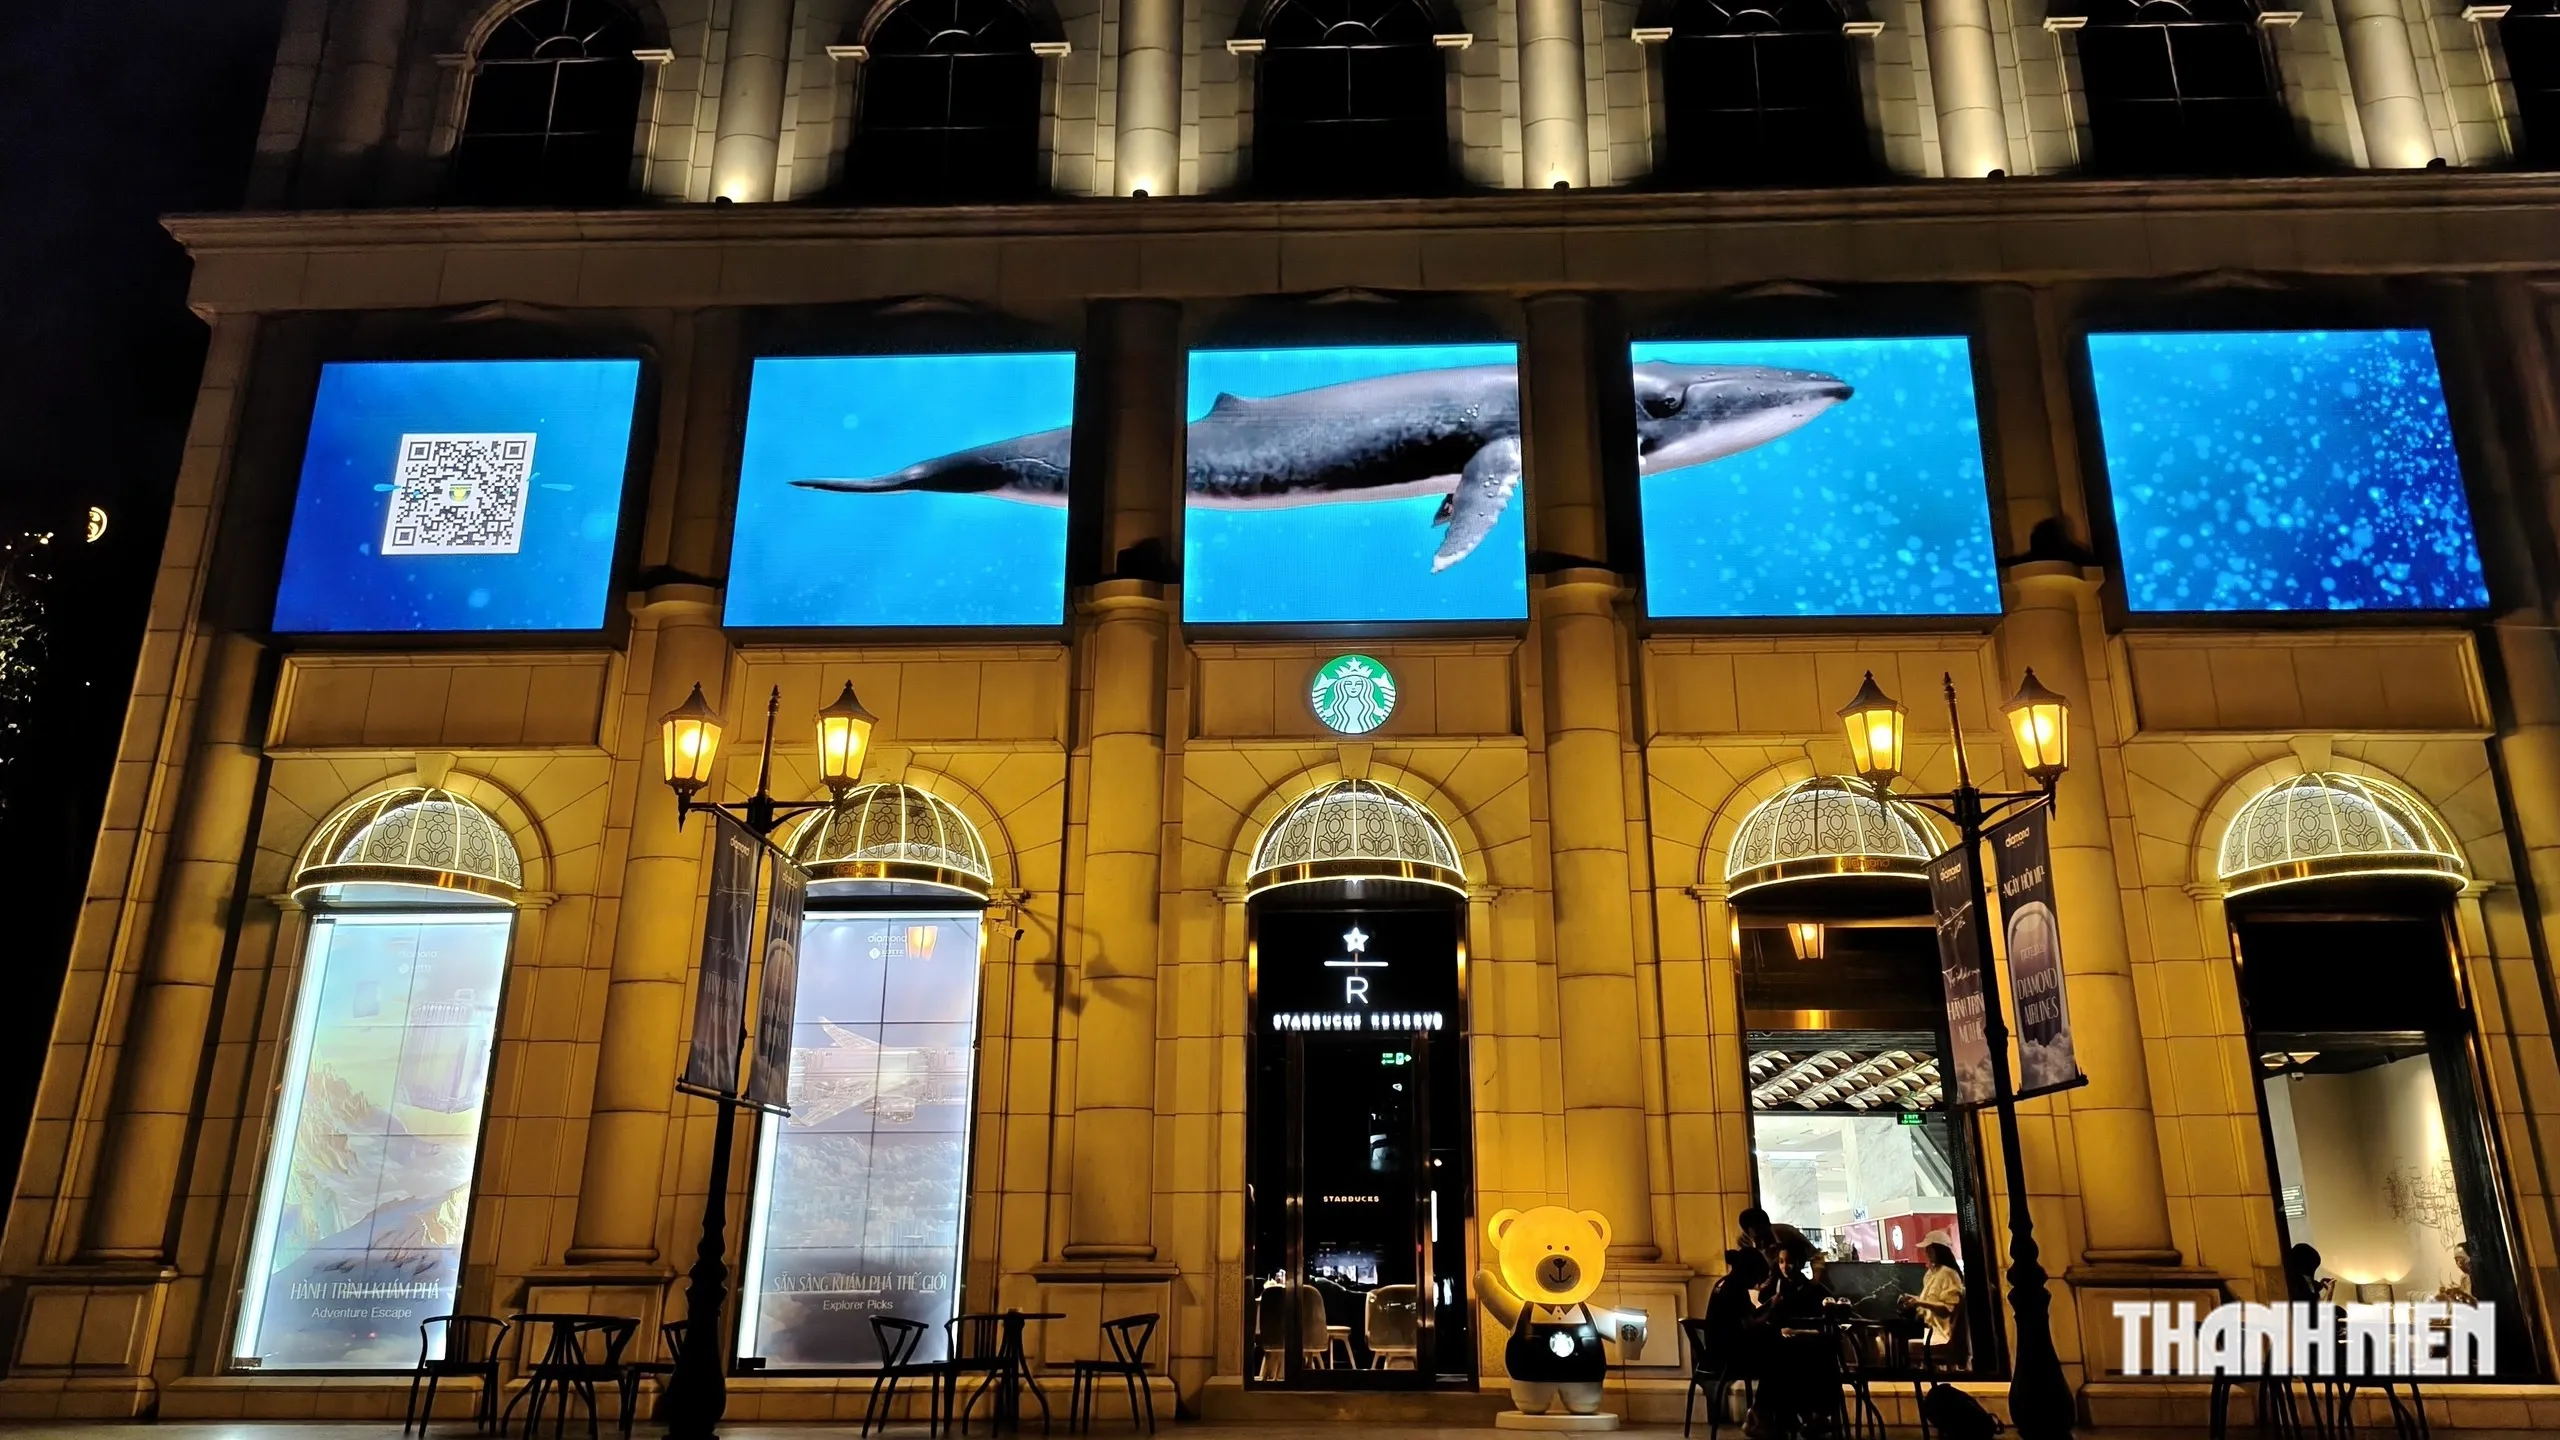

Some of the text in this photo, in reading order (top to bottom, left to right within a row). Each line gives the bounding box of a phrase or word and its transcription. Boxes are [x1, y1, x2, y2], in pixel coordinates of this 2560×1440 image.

[1346, 976, 1368, 1003] R
[2017, 967, 2058, 1000] DIAMOND
[1273, 1013, 1361, 1030] STARBUCKS
[1323, 1195, 1380, 1203] STARBUCKS
[290, 1278, 440, 1300] HÀNH TRÌNH KHÁM PHÁ
[799, 1272, 829, 1291] SÀNG
[832, 1272, 866, 1291] KHÁM
[869, 1272, 892, 1291] PHÁ
[311, 1307, 412, 1319] Adventure Escape
[823, 1300, 894, 1312] Explorer Picks
